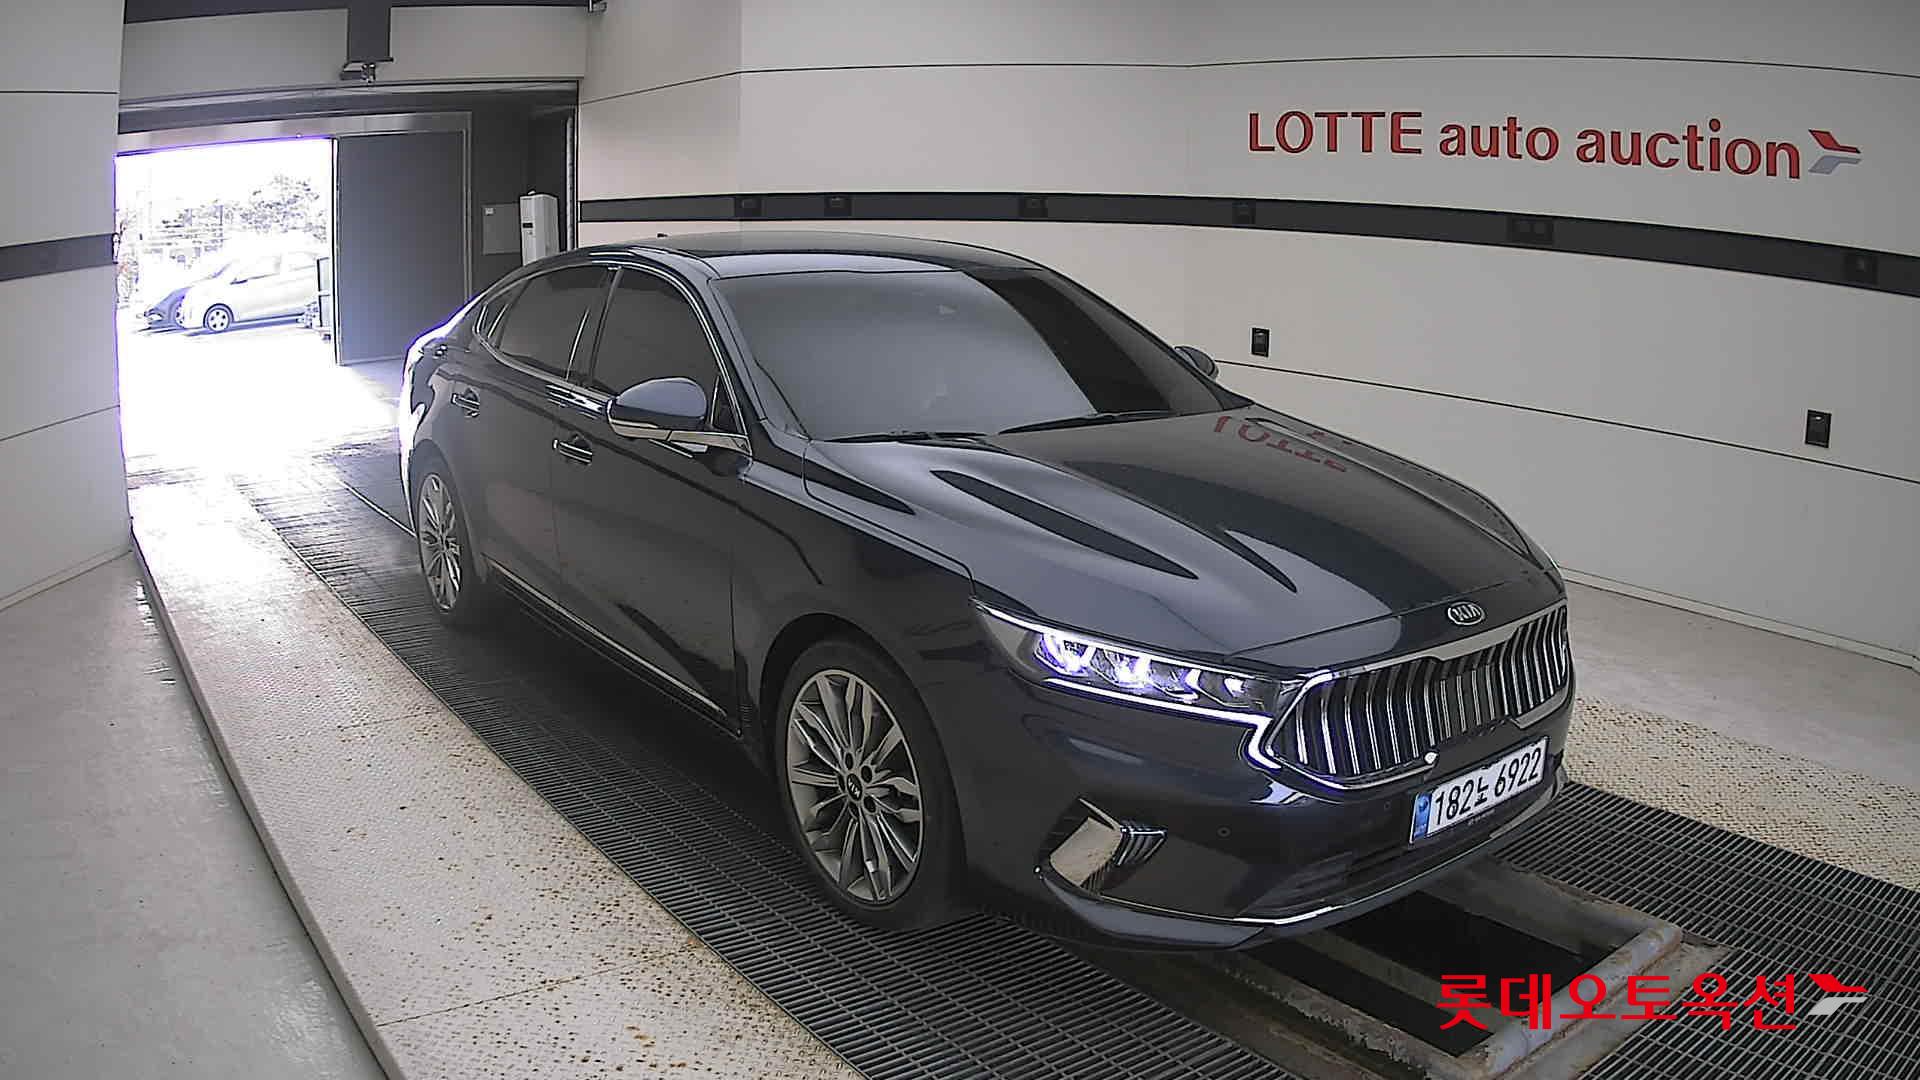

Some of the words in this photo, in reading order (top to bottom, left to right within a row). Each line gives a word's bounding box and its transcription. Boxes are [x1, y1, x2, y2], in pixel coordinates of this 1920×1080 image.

[1248, 111, 1423, 154] LOTTE
[1439, 116, 1560, 161] auto
[1576, 118, 1802, 179] auction
[1435, 777, 1489, 826] 182노
[1494, 747, 1542, 798] 6922
